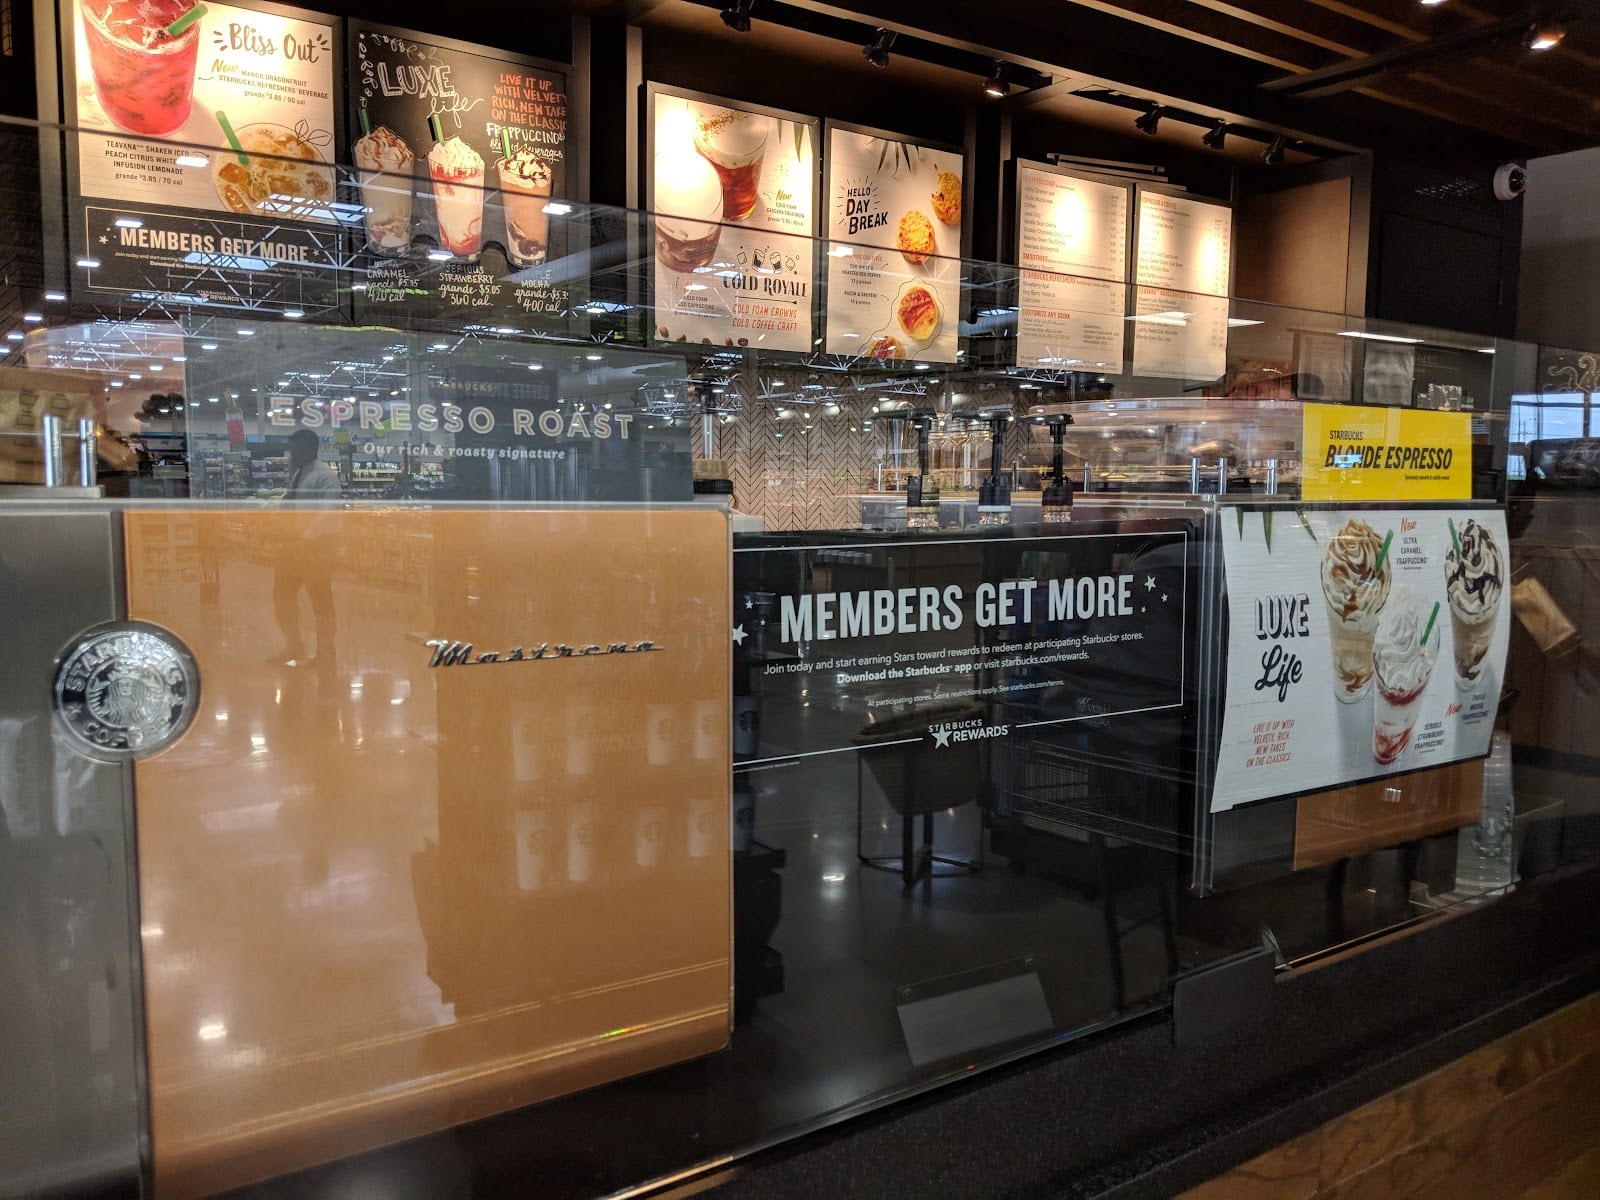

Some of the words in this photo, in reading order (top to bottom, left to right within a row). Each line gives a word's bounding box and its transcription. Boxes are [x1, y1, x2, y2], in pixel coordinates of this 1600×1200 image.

[229, 23, 278, 56] Bliss
[283, 33, 319, 64] Out
[211, 58, 239, 73] New
[218, 75, 256, 87] STARBUCKS
[298, 88, 329, 99] BEVERAGE
[265, 74, 307, 87] DRAGONFRUIT
[378, 62, 456, 99] LUXE
[500, 74, 522, 85] LIVE
[525, 77, 536, 89] IT
[539, 80, 552, 91] UP
[494, 85, 520, 99] WITH
[427, 93, 484, 128] life
[520, 102, 543, 114] NEW
[491, 108, 507, 122] ON
[510, 111, 527, 124] THE
[486, 122, 565, 144] FRPPUCCINO
[105, 150, 128, 160] PEACH
[129, 154, 155, 163] CITRUS
[145, 145, 173, 156] SHAKEN
[113, 160, 146, 171] INFUSION
[147, 164, 184, 175] LEMONADE
[776, 189, 792, 201] New
[847, 187, 871, 197] HELLO
[846, 199, 870, 217] DAY
[848, 211, 888, 235] BREAK
[120, 227, 215, 254] MEMBERS
[220, 236, 255, 257] GET
[259, 241, 309, 264] MORE
[367, 269, 410, 279] CARAMEL
[446, 264, 484, 275] SERIOUS
[398, 279, 420, 289] $5.35
[439, 273, 494, 284] STRAWBERRY
[521, 280, 550, 289] MOCHA
[723, 272, 759, 291] COLD
[764, 276, 808, 298] ROYALE
[368, 289, 387, 302] 420
[438, 284, 477, 298] grande
[479, 285, 501, 295] $5.05
[514, 288, 551, 303] grande
[450, 294, 470, 306] 360
[523, 299, 543, 312] 400
[732, 303, 749, 314] COLD
[751, 305, 769, 316] FOAM
[771, 306, 798, 319] CROWNS
[732, 317, 749, 328] COLD
[752, 319, 775, 331] COFFEE
[777, 321, 798, 332] CRAFT
[270, 397, 495, 434] ESPRESSO
[512, 408, 634, 440] ROAST
[1329, 430, 1365, 441] STARBUCKS
[364, 442, 393, 455] Our
[400, 444, 429, 456] rich
[433, 444, 445, 456] &
[449, 446, 495, 460] roasty
[498, 446, 566, 461] signature
[1384, 446, 1453, 470] ESPRESSO
[1401, 517, 1418, 534] New
[1400, 547, 1422, 555] CARAMEL
[780, 585, 963, 643] MEMBERS
[976, 581, 1037, 628] GET
[1048, 574, 1134, 622] MORE
[1254, 593, 1310, 640] LUXE
[425, 639, 664, 667] Mastrena
[763, 663, 785, 675] Join
[786, 661, 814, 676] today
[815, 658, 834, 670] and
[835, 657, 857, 669] start
[858, 654, 892, 667] earning
[894, 651, 916, 662] Stars
[917, 648, 946, 660] toward
[947, 645, 980, 658] rewards
[981, 645, 991, 654] to
[992, 642, 1023, 653] redeem
[1024, 642, 1033, 650] at
[1033, 637, 1081, 651] participating
[1120, 632, 1144, 641] stores.
[836, 668, 886, 684] Download
[887, 667, 904, 678] the
[954, 662, 972, 674] app
[983, 659, 1000, 669] visit
[1001, 650, 1090, 668] starbucks.com/rewards.
[1254, 644, 1303, 703] Life
[867, 699, 875, 707] At
[875, 695, 913, 708] participating
[933, 691, 950, 700] Some
[950, 688, 981, 699] restrictions
[999, 685, 1010, 693] See
[1445, 703, 1462, 718] New
[953, 725, 1009, 742] REWARDS
[1253, 722, 1265, 733] LIVE
[1266, 721, 1271, 731] IT
[1272, 720, 1280, 731] UP
[1281, 719, 1295, 729] WITH
[1256, 745, 1269, 755] NEW
[1270, 742, 1286, 753] TAKES
[1246, 758, 1254, 768] ON
[1255, 756, 1265, 766] THE
[1266, 752, 1291, 765] CLASSICS
